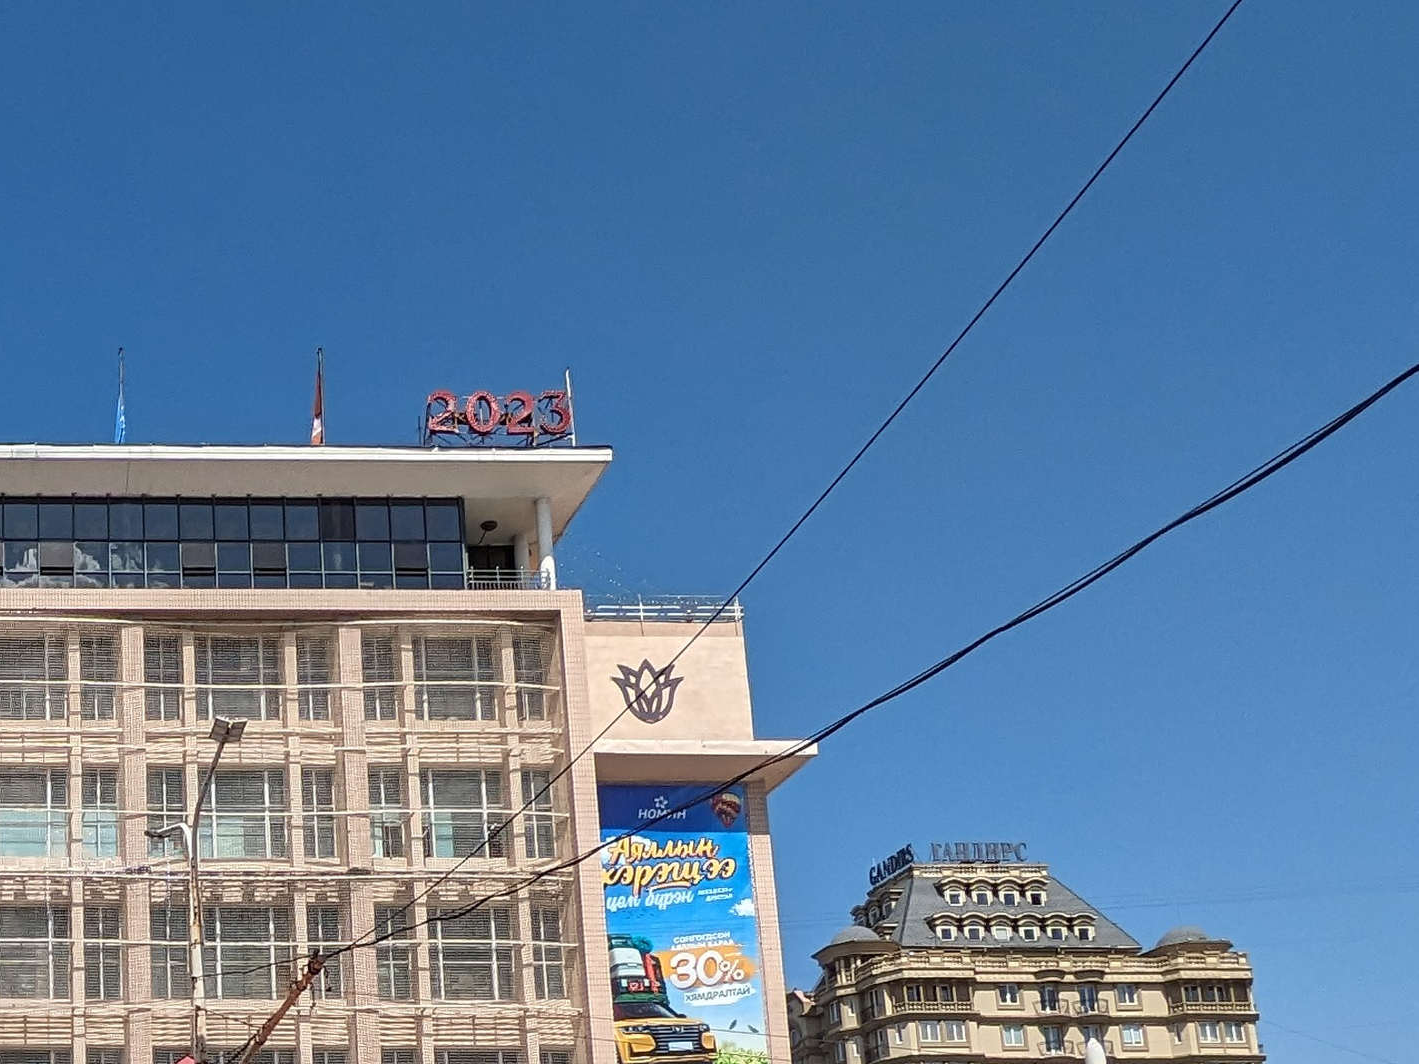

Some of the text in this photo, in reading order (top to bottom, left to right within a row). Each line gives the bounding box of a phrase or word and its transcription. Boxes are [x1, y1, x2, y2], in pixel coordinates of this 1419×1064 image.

[427, 389, 572, 435] 2023
[638, 808, 687, 820] НОМИН
[669, 949, 745, 990] 30%
